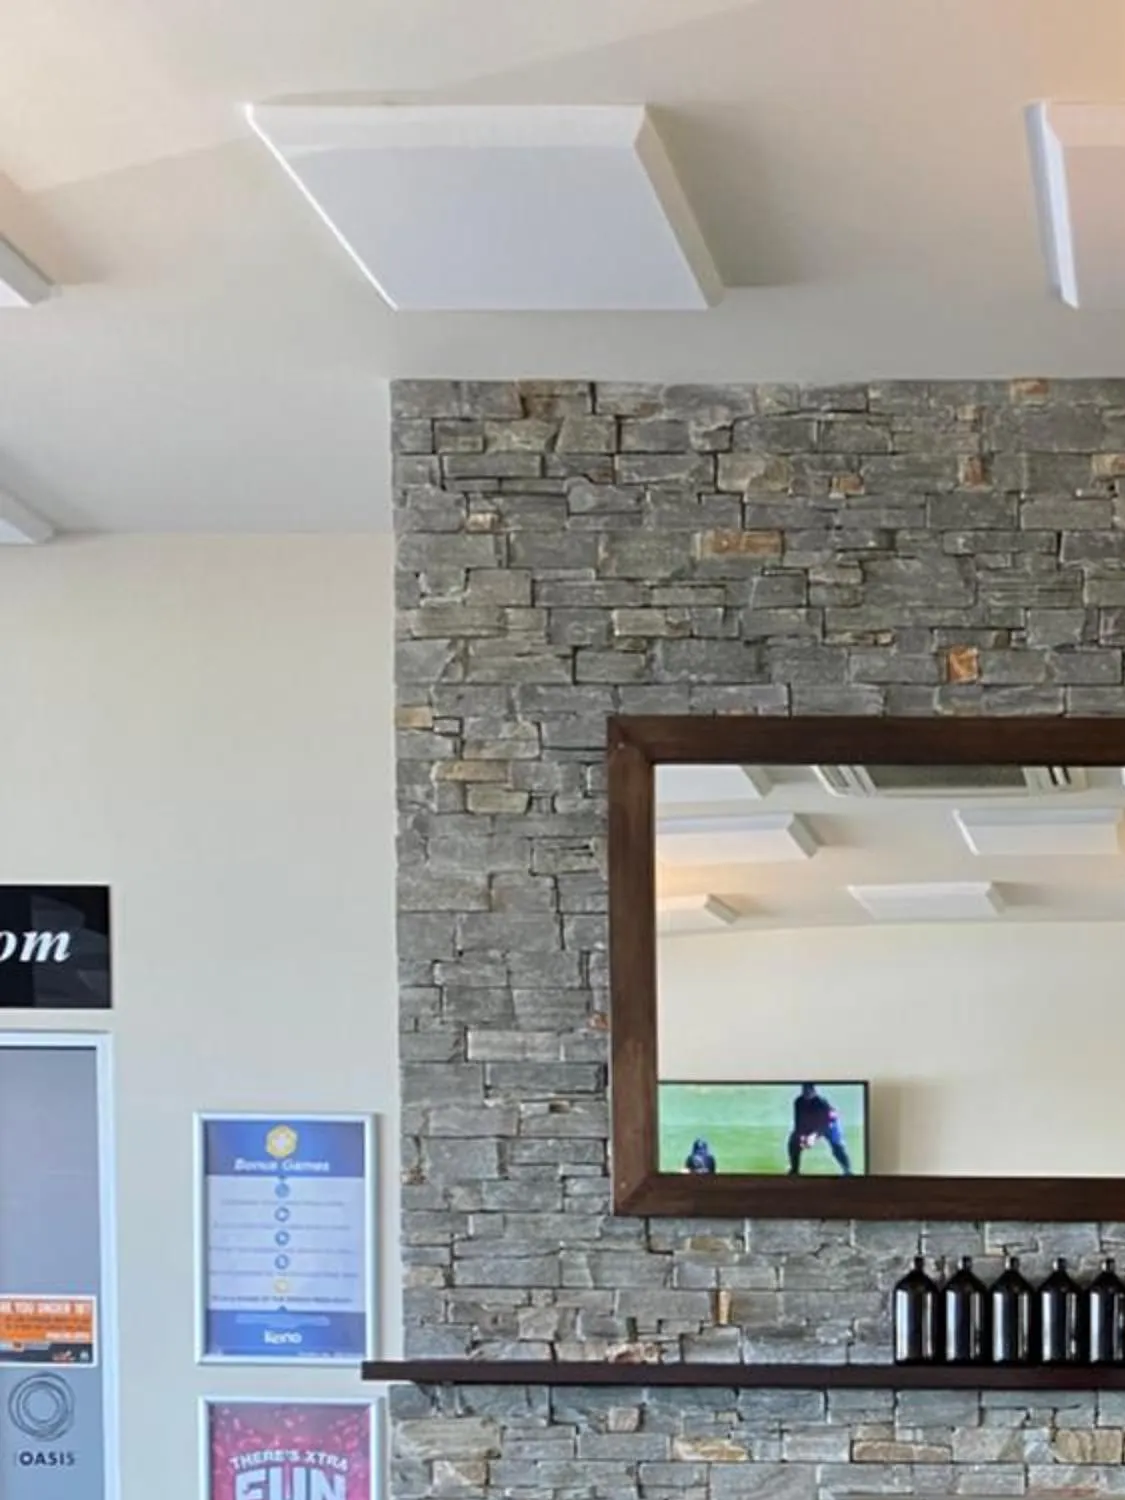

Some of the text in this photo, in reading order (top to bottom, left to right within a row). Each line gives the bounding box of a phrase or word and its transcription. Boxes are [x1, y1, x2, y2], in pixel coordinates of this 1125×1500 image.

[19, 1451, 75, 1467] OASIS
[229, 1451, 349, 1472] THERE'S XTRA
